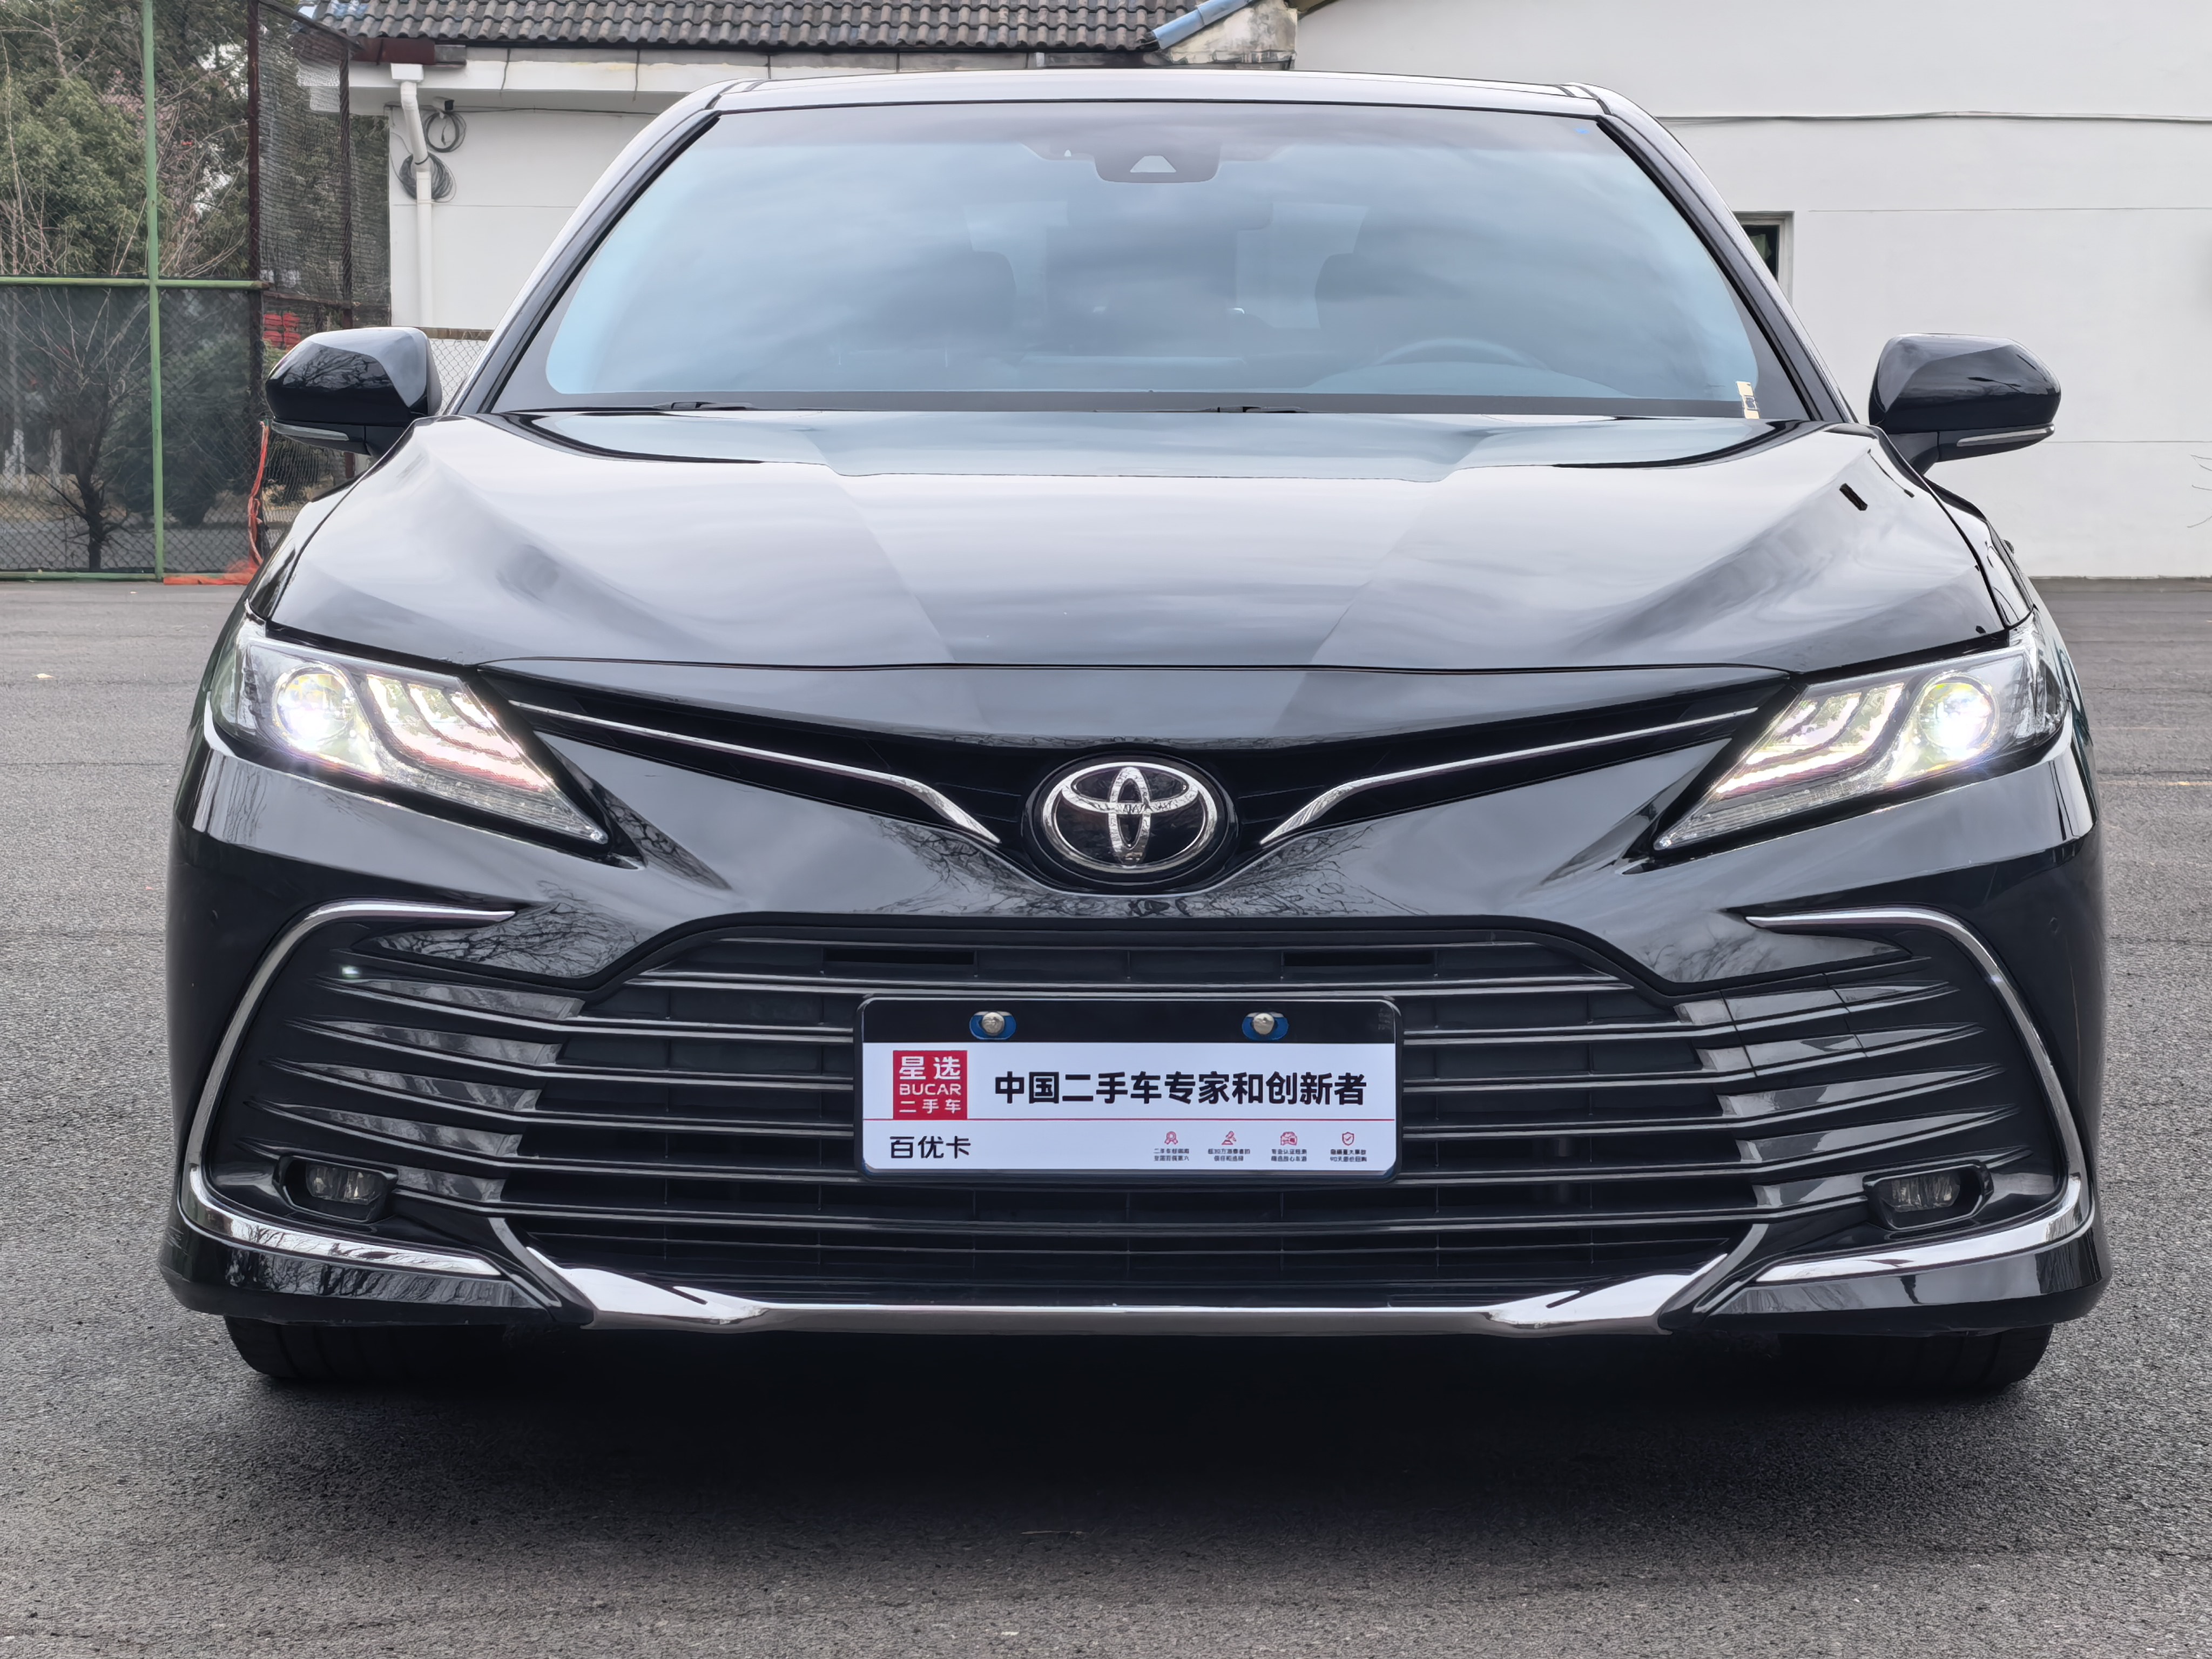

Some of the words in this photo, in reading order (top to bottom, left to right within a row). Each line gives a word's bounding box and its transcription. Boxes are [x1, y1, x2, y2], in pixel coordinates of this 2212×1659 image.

[899, 1056, 961, 1080] 星选
[899, 1083, 961, 1095] BUCAR
[994, 1071, 1367, 1105] 中国二手车专家和创新者
[899, 1098, 961, 1114] 二手车
[889, 1136, 971, 1159] 百优卡
